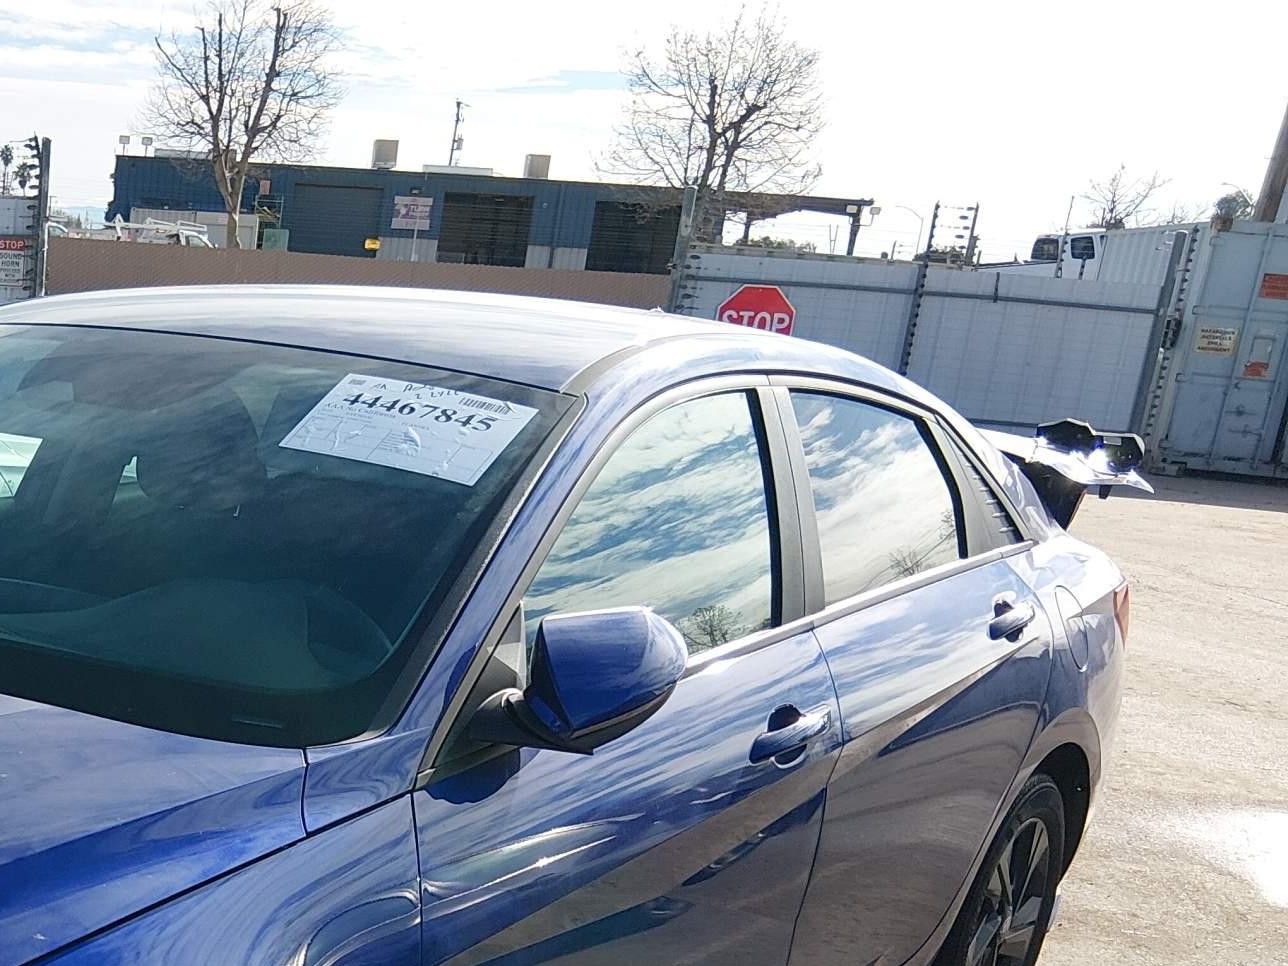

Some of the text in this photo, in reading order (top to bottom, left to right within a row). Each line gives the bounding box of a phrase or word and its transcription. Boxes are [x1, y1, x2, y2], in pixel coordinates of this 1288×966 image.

[0, 252, 22, 260] SOUND
[1, 260, 20, 268] HORN
[342, 393, 499, 431] 44467845
